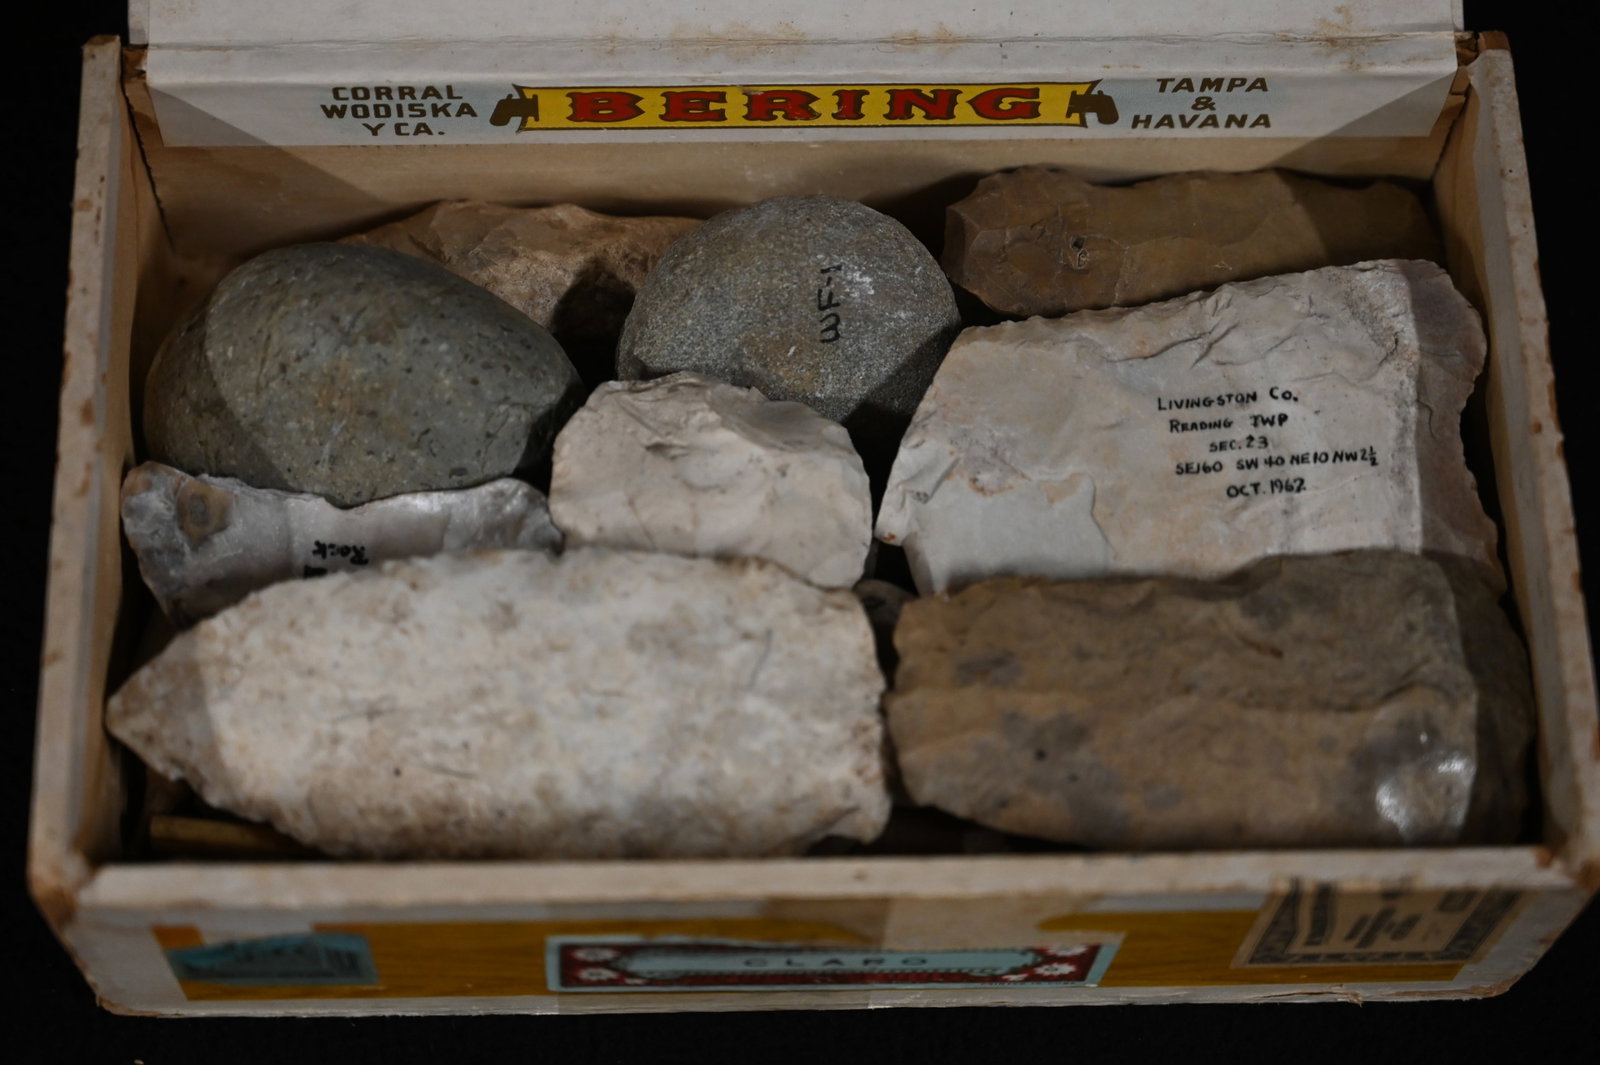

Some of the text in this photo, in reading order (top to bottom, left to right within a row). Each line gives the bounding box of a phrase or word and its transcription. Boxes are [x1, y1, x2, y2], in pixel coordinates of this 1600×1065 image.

[332, 85, 463, 101] CORRAL
[1156, 77, 1268, 93] TAMPA
[320, 102, 478, 119] WODISKA
[565, 87, 1043, 123] BERING
[1190, 96, 1216, 111] &
[1131, 114, 1271, 129] HAVANA
[1157, 391, 1258, 411] LIVINGSTON
[1169, 419, 1234, 433] READING
[743, 956, 928, 968] CLARO
